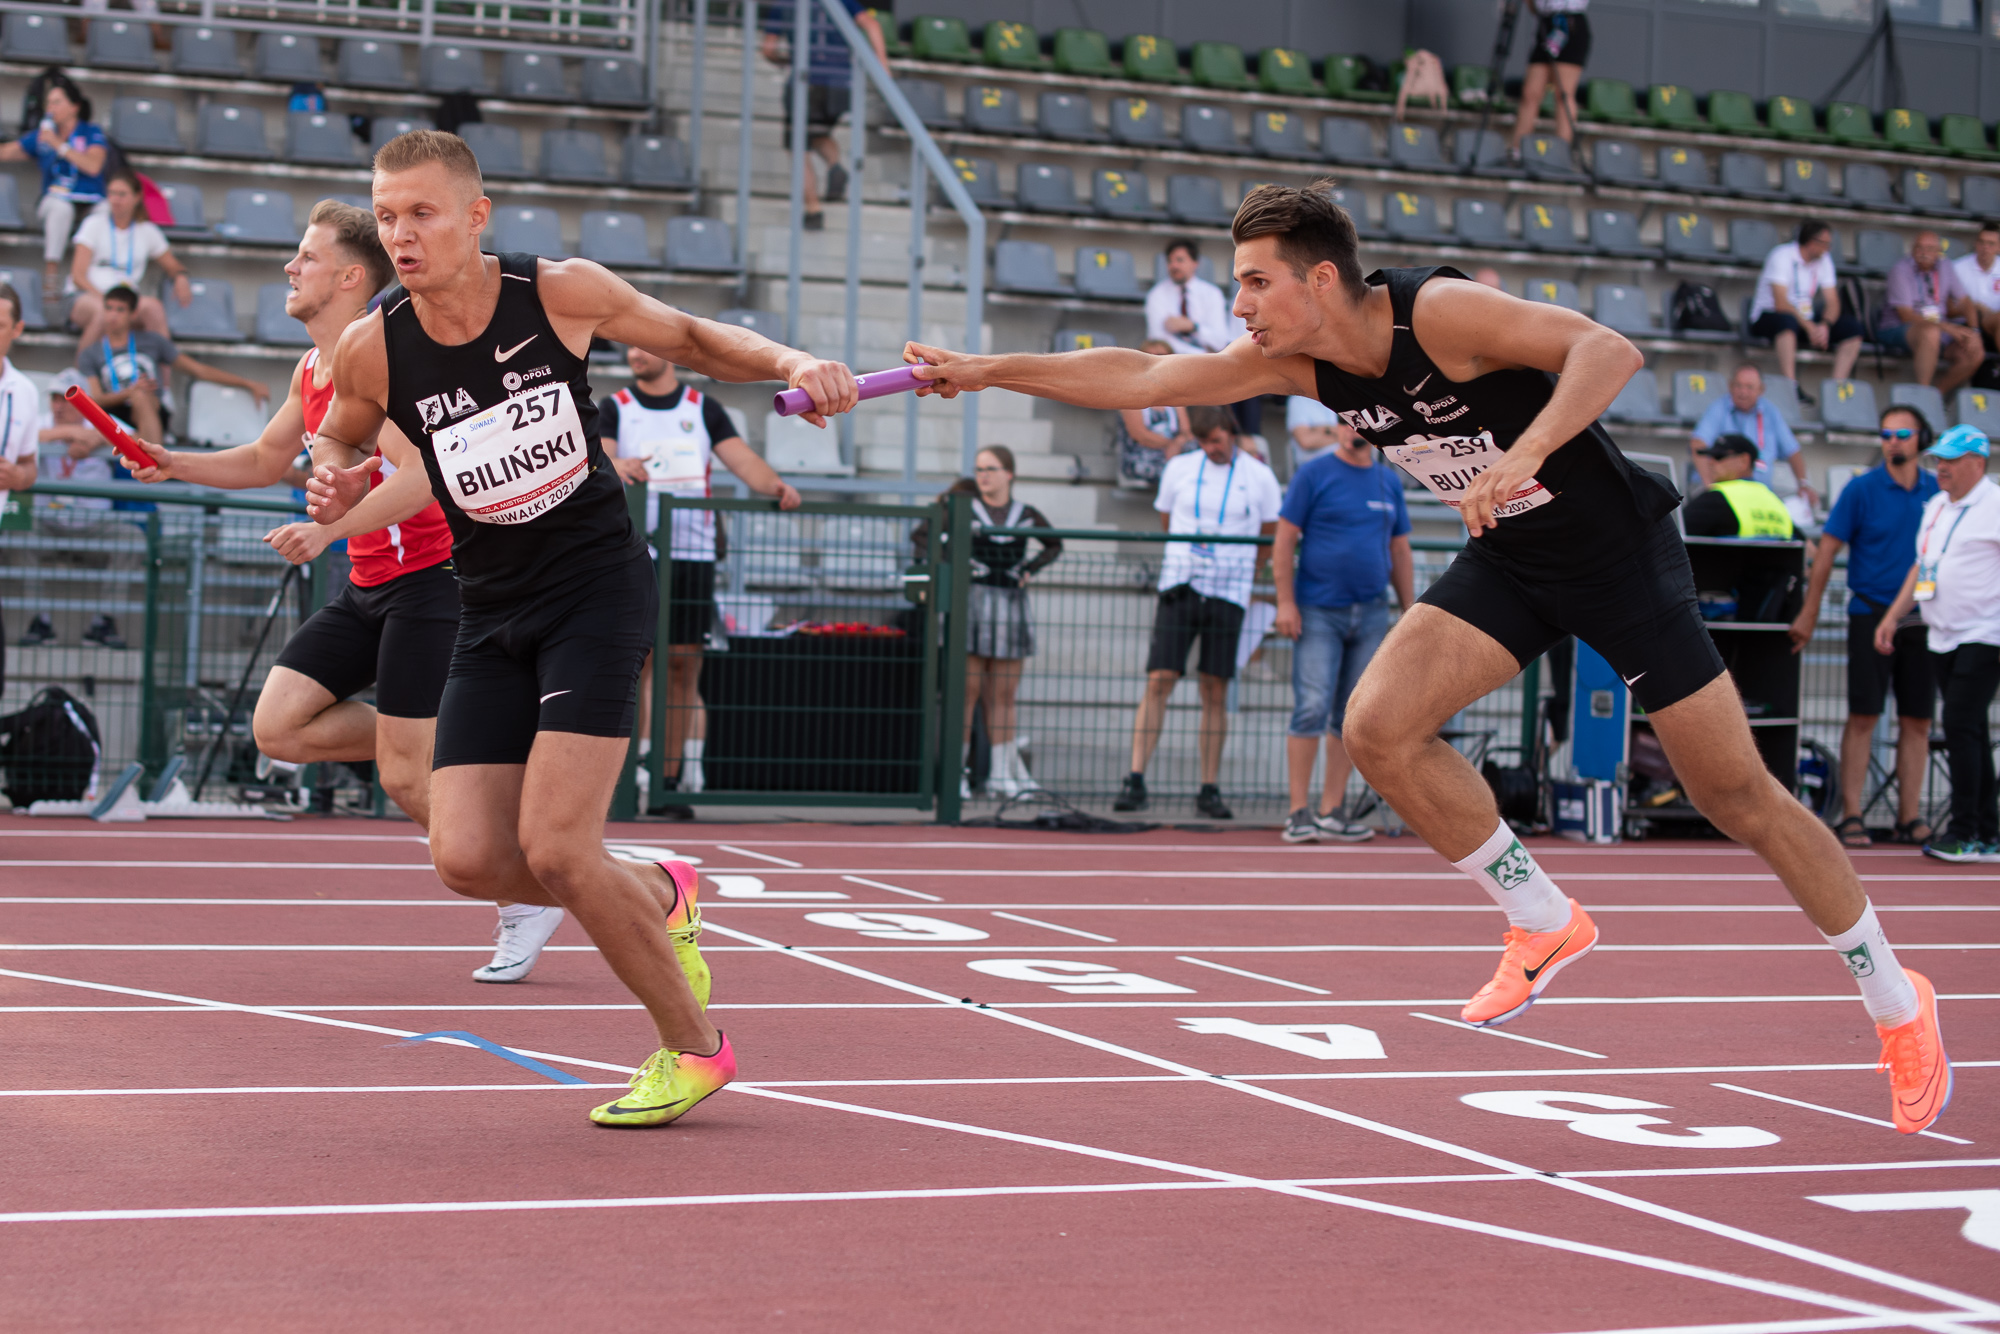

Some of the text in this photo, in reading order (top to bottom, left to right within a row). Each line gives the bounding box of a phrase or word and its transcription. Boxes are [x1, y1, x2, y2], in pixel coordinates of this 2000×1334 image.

[522, 367, 552, 381] OPOLE
[506, 388, 561, 432] 257
[1430, 395, 1458, 411] OPOLE
[1430, 404, 1470, 424] OPOLSKIE
[456, 430, 577, 497] BILIŃSKI
[1439, 437, 1488, 458] 259
[488, 480, 575, 524] SUWAŁKI 2021
[500, 485, 551, 509] MISTRZOSTWA
[551, 470, 574, 489] POLSKI
[1505, 499, 1534, 514] 2021
[966, 958, 1197, 993] 5
[1174, 1017, 1388, 1060] 4
[1459, 1090, 1781, 1148] 3
